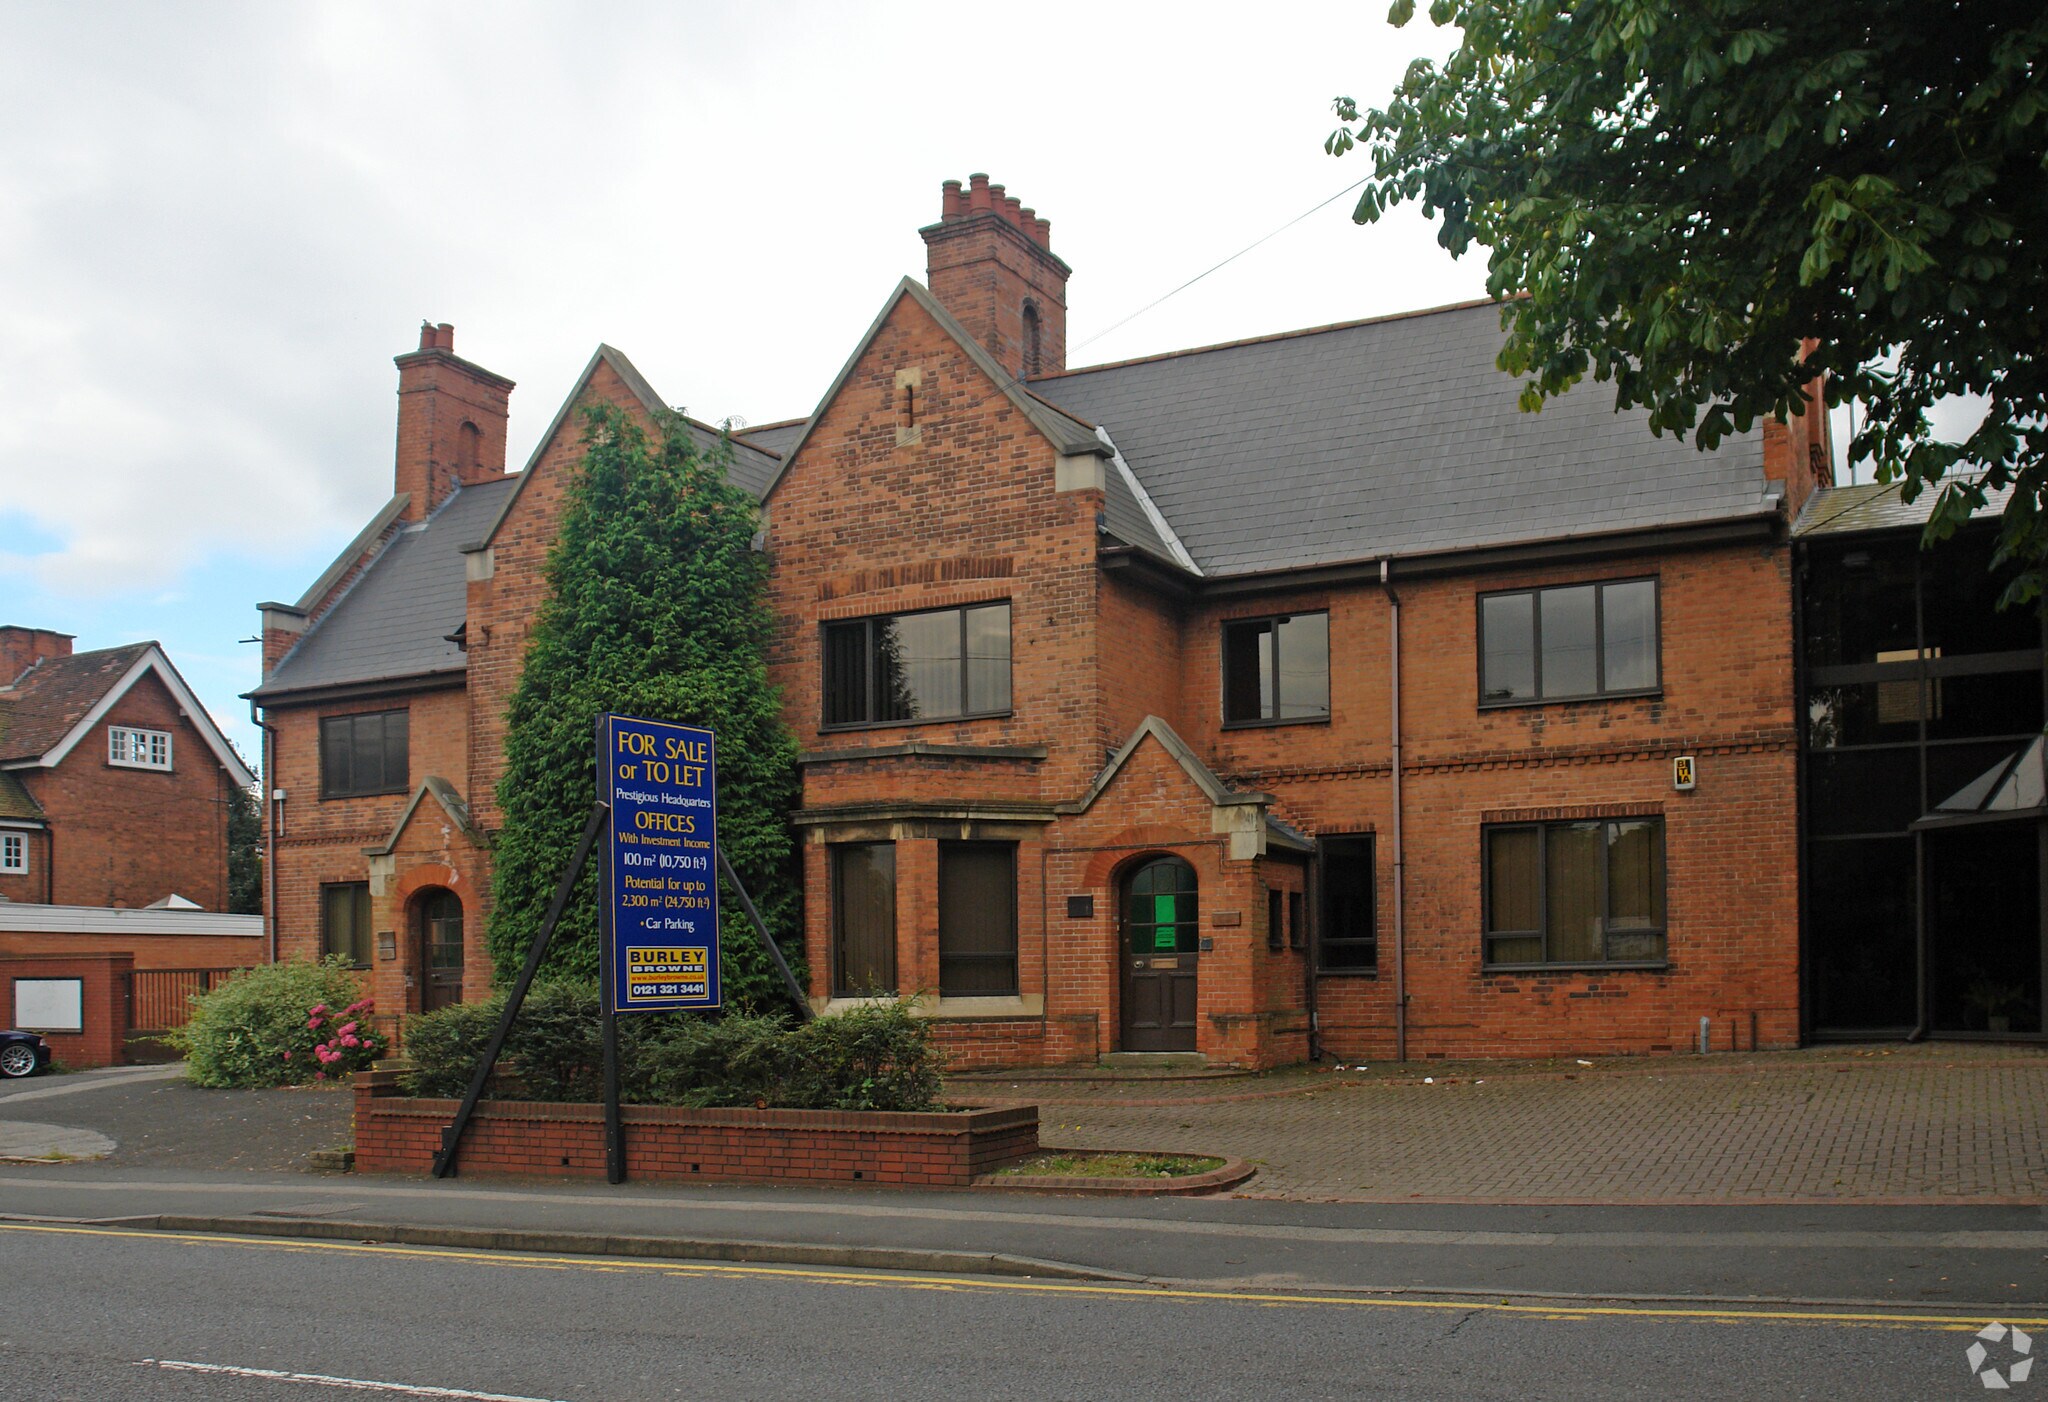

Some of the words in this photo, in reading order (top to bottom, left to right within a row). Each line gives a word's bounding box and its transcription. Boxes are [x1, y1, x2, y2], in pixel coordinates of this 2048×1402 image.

[618, 731, 657, 756] FOR
[665, 738, 708, 763] SALE
[619, 764, 638, 780] or
[642, 760, 670, 783] TO
[675, 764, 705, 787] LET
[616, 788, 659, 804] Prestigious
[662, 793, 711, 808] Headquarters
[635, 811, 695, 833] OFFICES
[618, 832, 638, 844] With
[642, 834, 681, 847] Investment
[684, 837, 710, 849] Income
[624, 852, 641, 866] 100
[660, 854, 691, 869] (10,750
[625, 875, 664, 890] Potential
[668, 877, 680, 890] for
[684, 882, 695, 894] up
[696, 880, 706, 891] to
[622, 894, 648, 907] 2,300
[665, 895, 696, 909] (24,750
[646, 918, 661, 930] Car
[665, 918, 695, 933] Parking
[631, 952, 704, 962] BURLEY
[633, 985, 656, 994] 0121
[660, 985, 677, 994] 321
[681, 984, 704, 993] 3441
